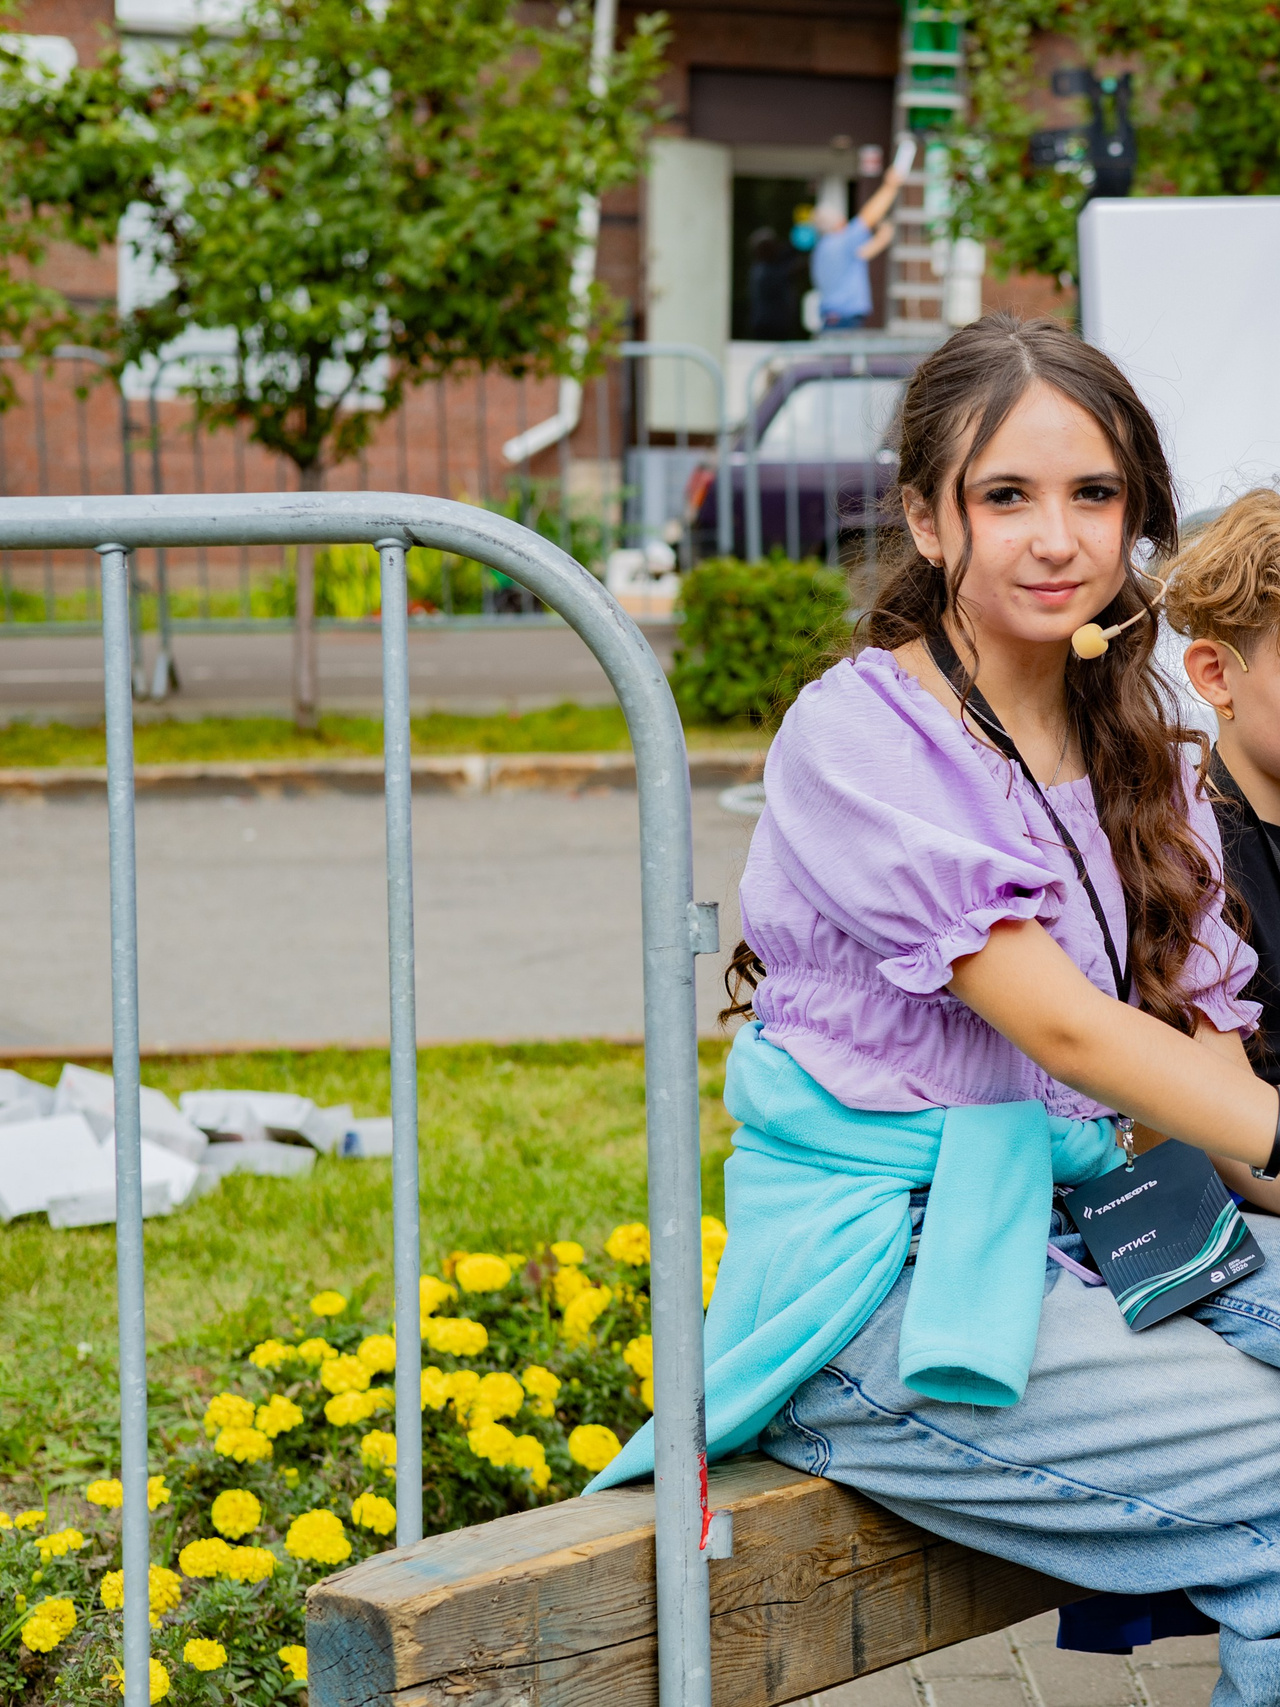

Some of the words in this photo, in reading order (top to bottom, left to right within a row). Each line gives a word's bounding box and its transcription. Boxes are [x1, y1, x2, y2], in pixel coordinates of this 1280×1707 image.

[1095, 1180, 1158, 1215] ТАТНЕФТЬ
[1111, 1229, 1157, 1260] АРТИСТ
[1232, 1263, 1249, 1274] 2026
